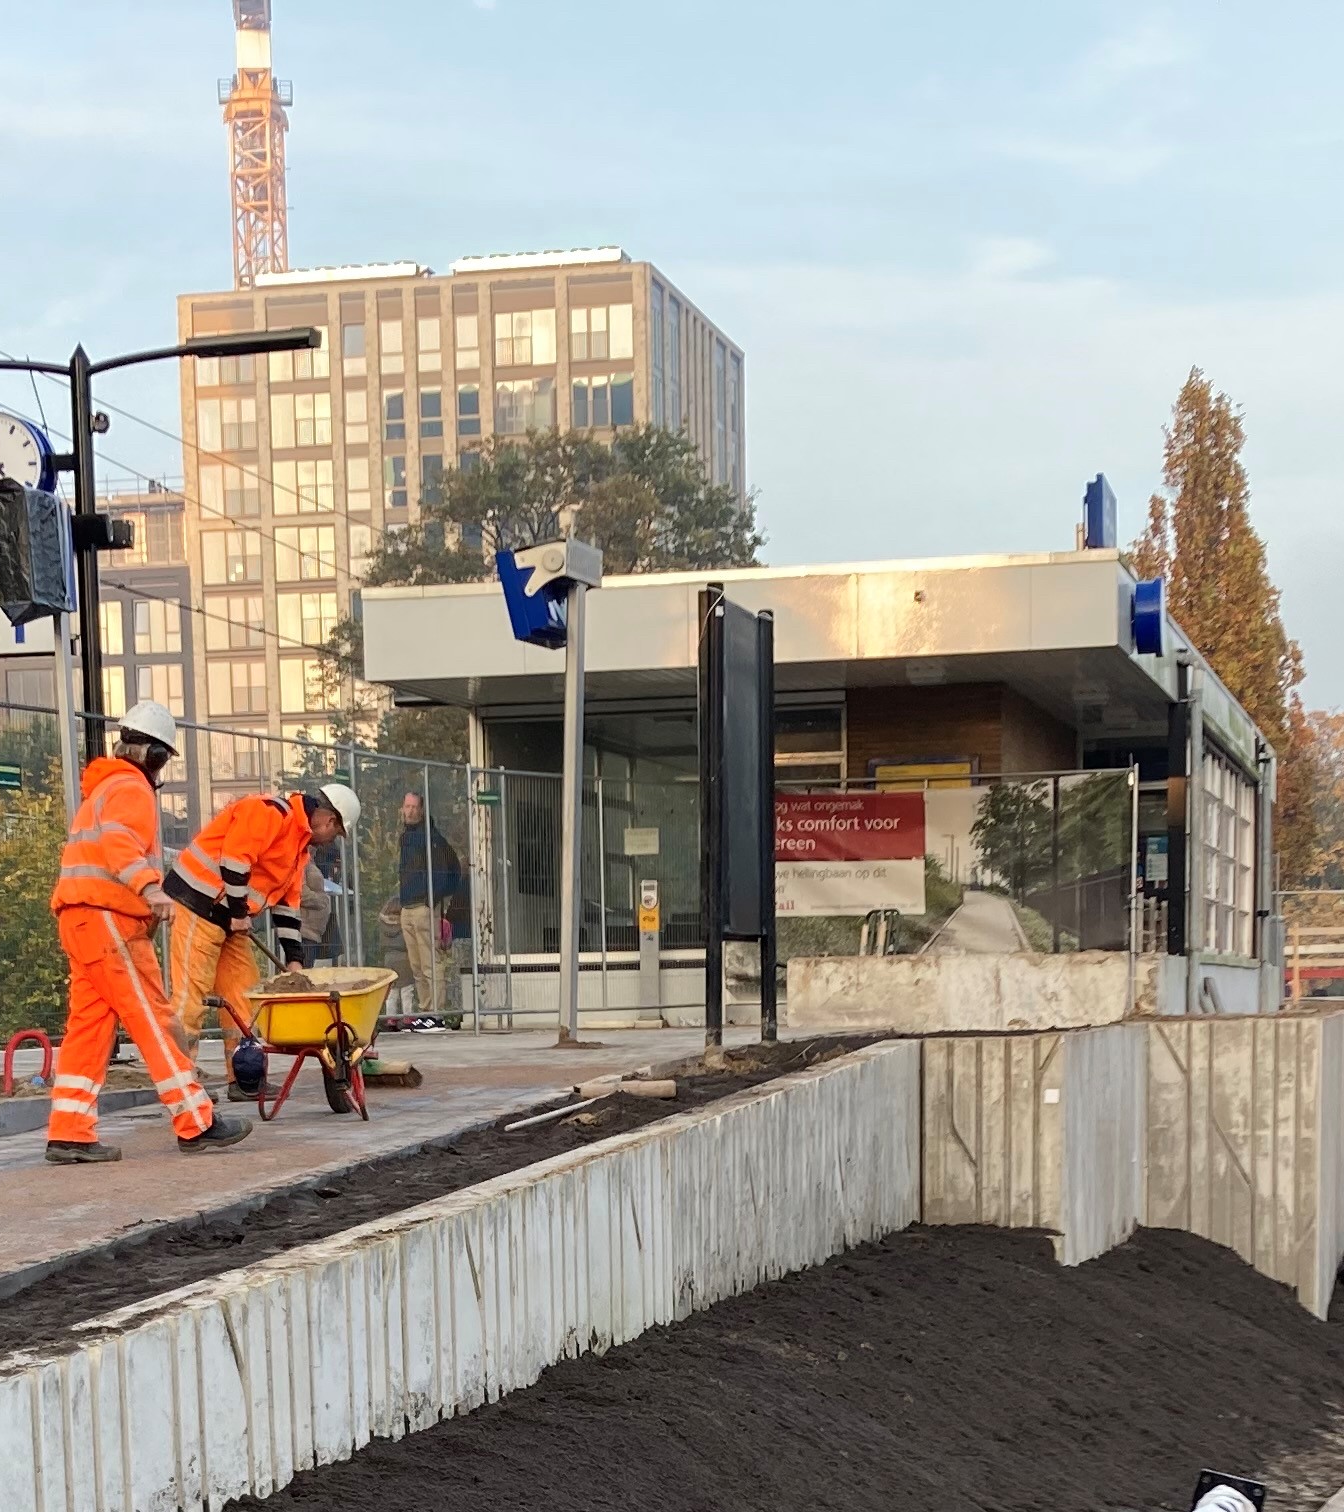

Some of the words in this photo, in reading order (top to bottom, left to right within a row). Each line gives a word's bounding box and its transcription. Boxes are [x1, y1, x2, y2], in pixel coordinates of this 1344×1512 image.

[790, 801, 811, 811] wat
[814, 800, 864, 813] ongemak
[797, 815, 860, 832] comfort
[864, 817, 901, 831] voor
[792, 867, 852, 881] hellingbaan
[855, 868, 870, 880] op
[872, 867, 887, 879] dit
